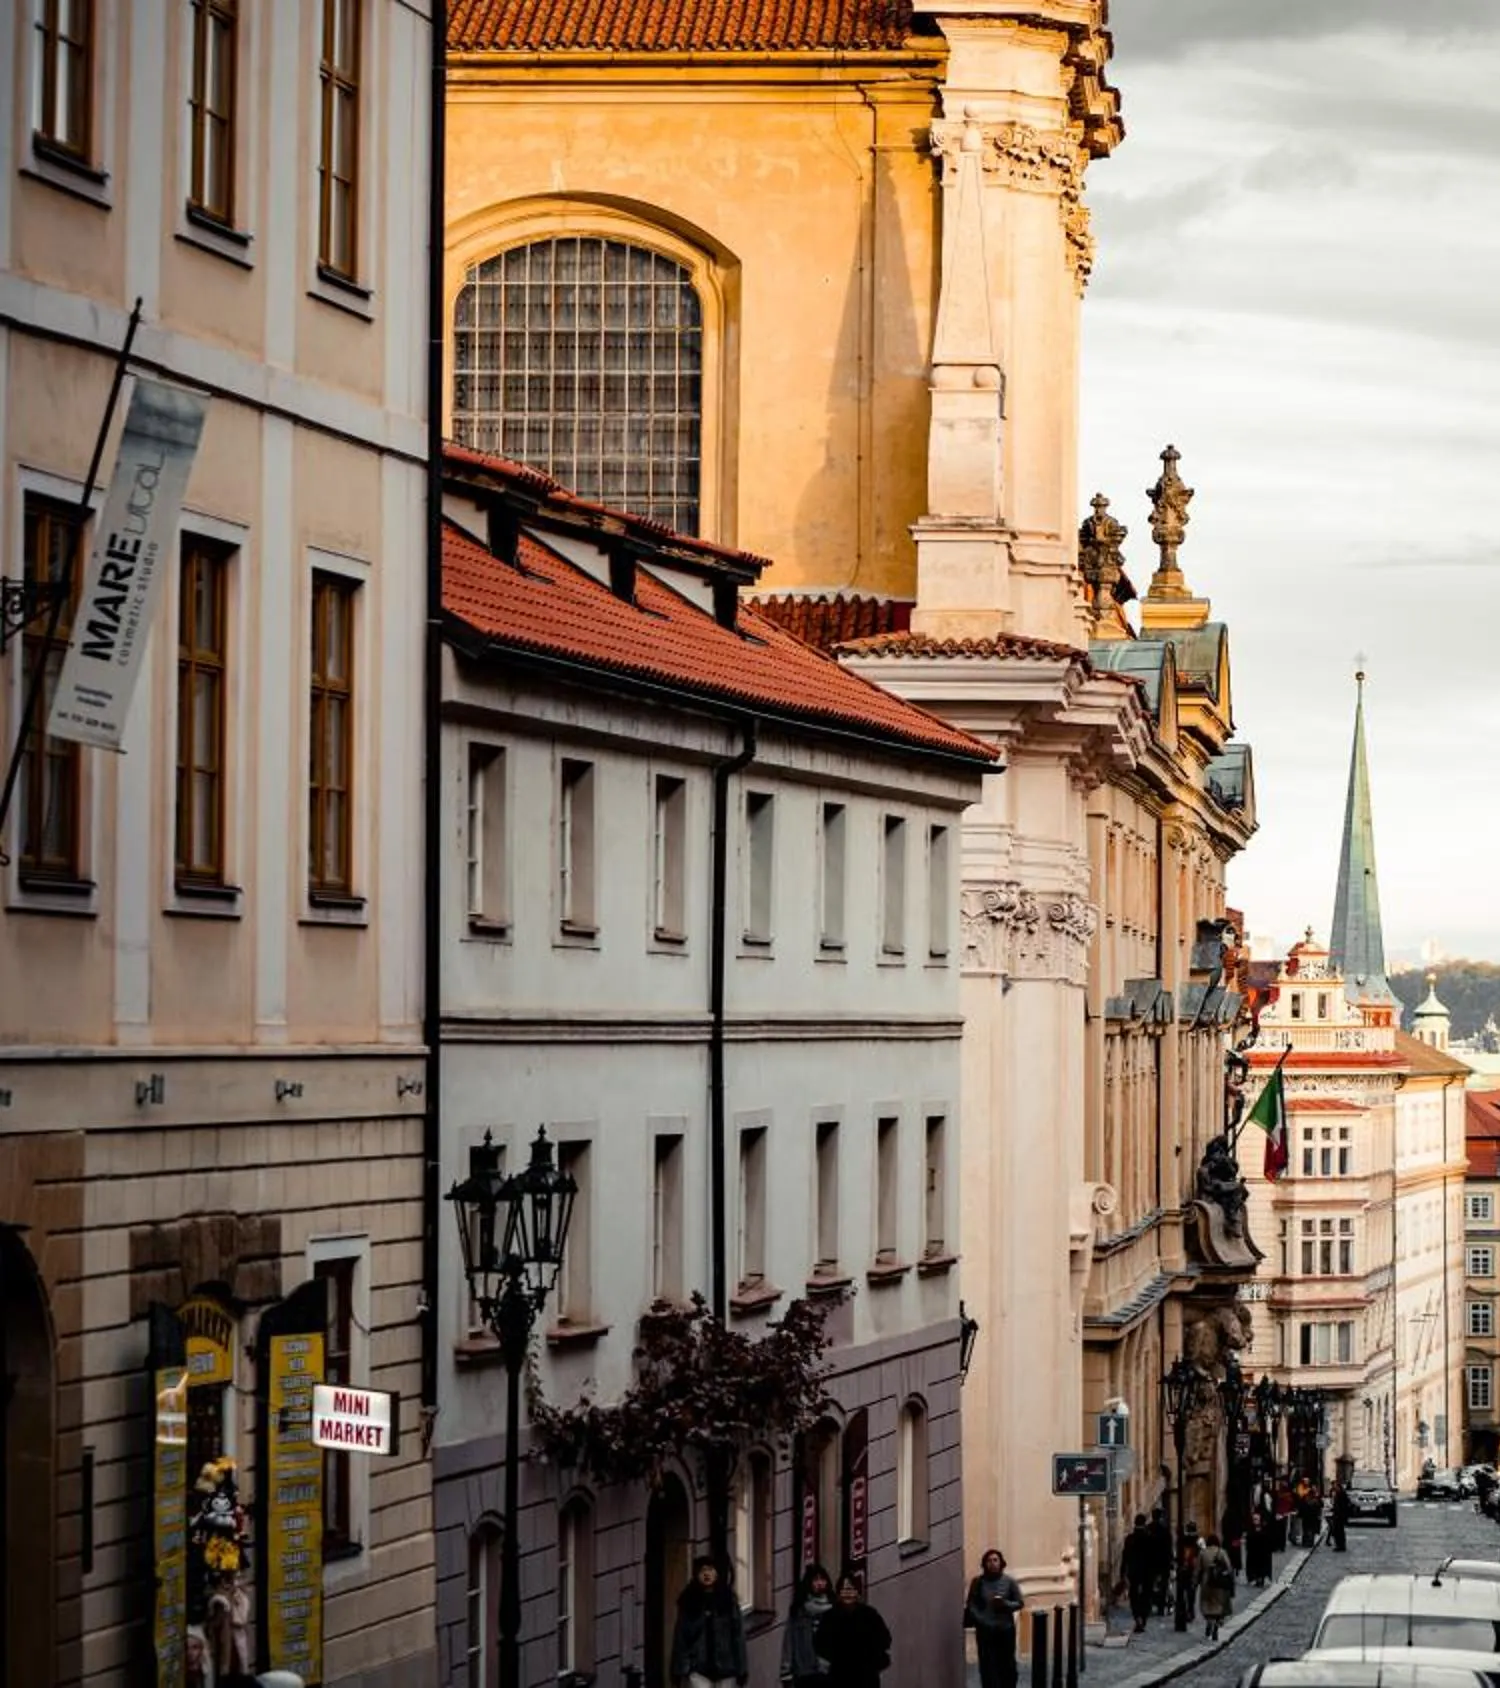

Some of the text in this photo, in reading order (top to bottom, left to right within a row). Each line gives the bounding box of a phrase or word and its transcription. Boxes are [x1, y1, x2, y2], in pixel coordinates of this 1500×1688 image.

[80, 533, 142, 661] MARE
[117, 541, 159, 667] cosmetic studio
[319, 1419, 384, 1447] MARKET
[333, 1391, 370, 1417] MINI
